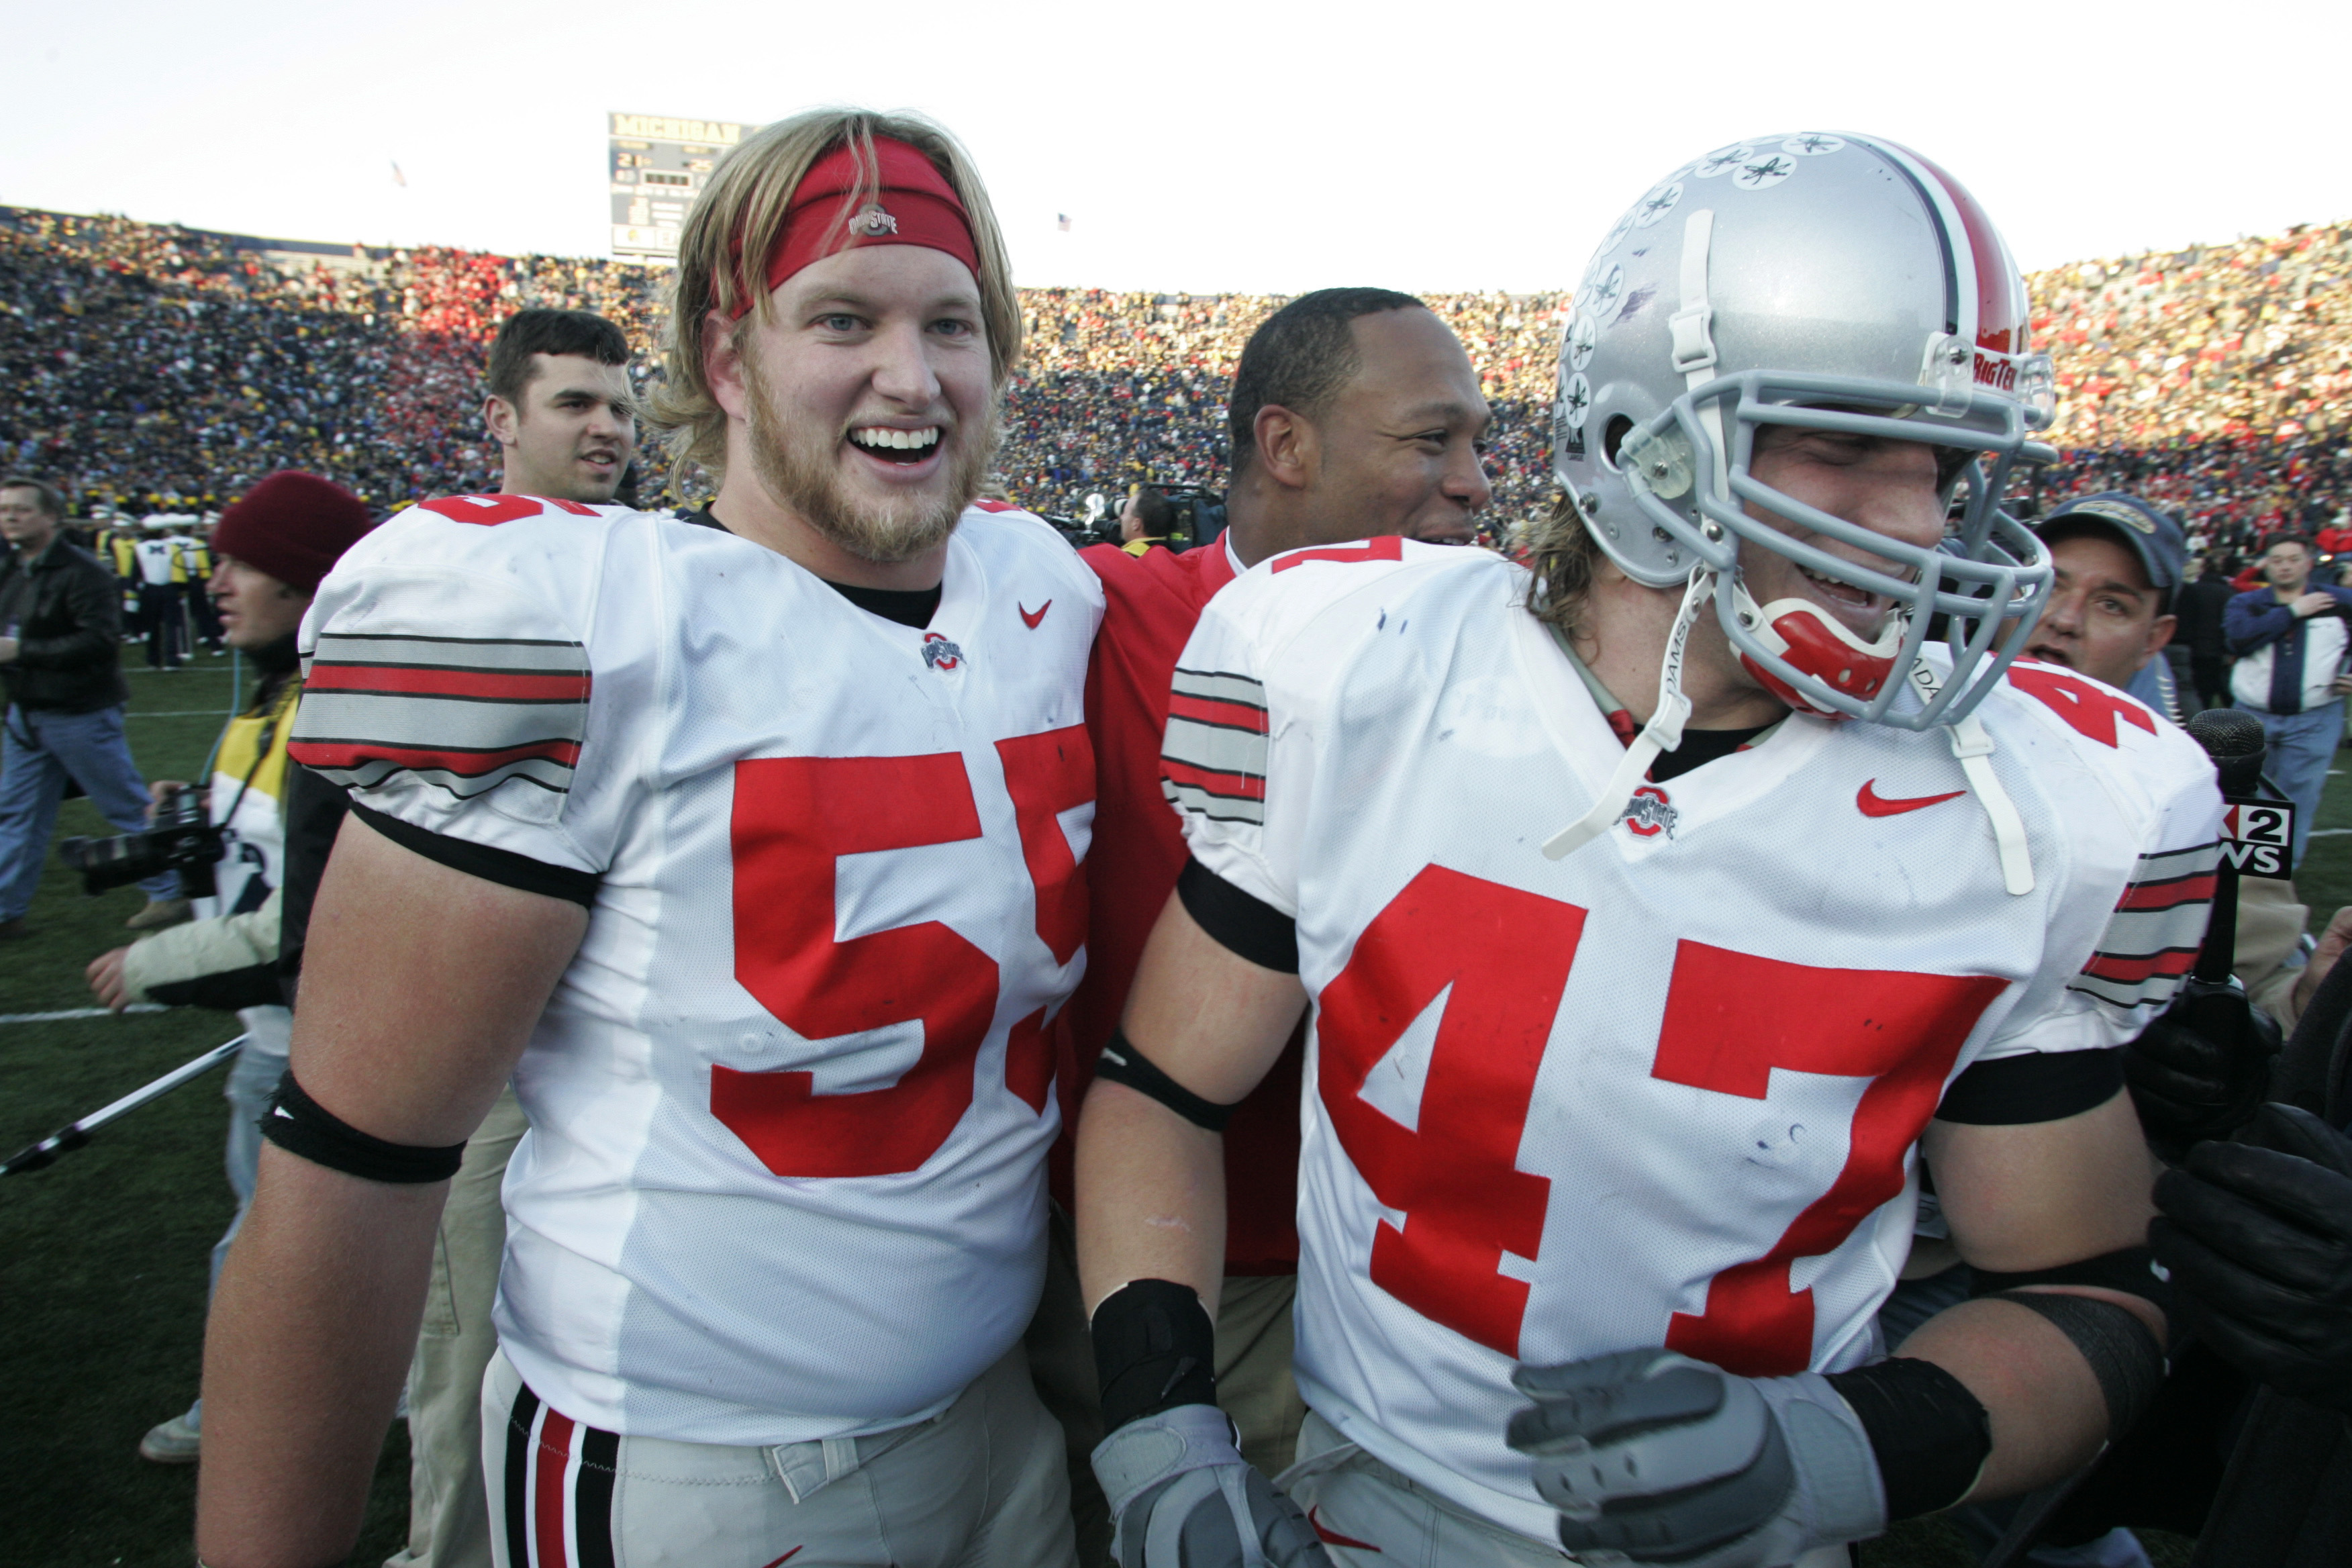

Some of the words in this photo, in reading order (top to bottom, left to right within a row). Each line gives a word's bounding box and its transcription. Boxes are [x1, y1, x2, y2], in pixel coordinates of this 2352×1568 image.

[614, 113, 741, 144] MICHIGAN
[2246, 809, 2282, 843] 2
[710, 722, 1097, 1178] 55
[1317, 863, 2012, 1378] 47
